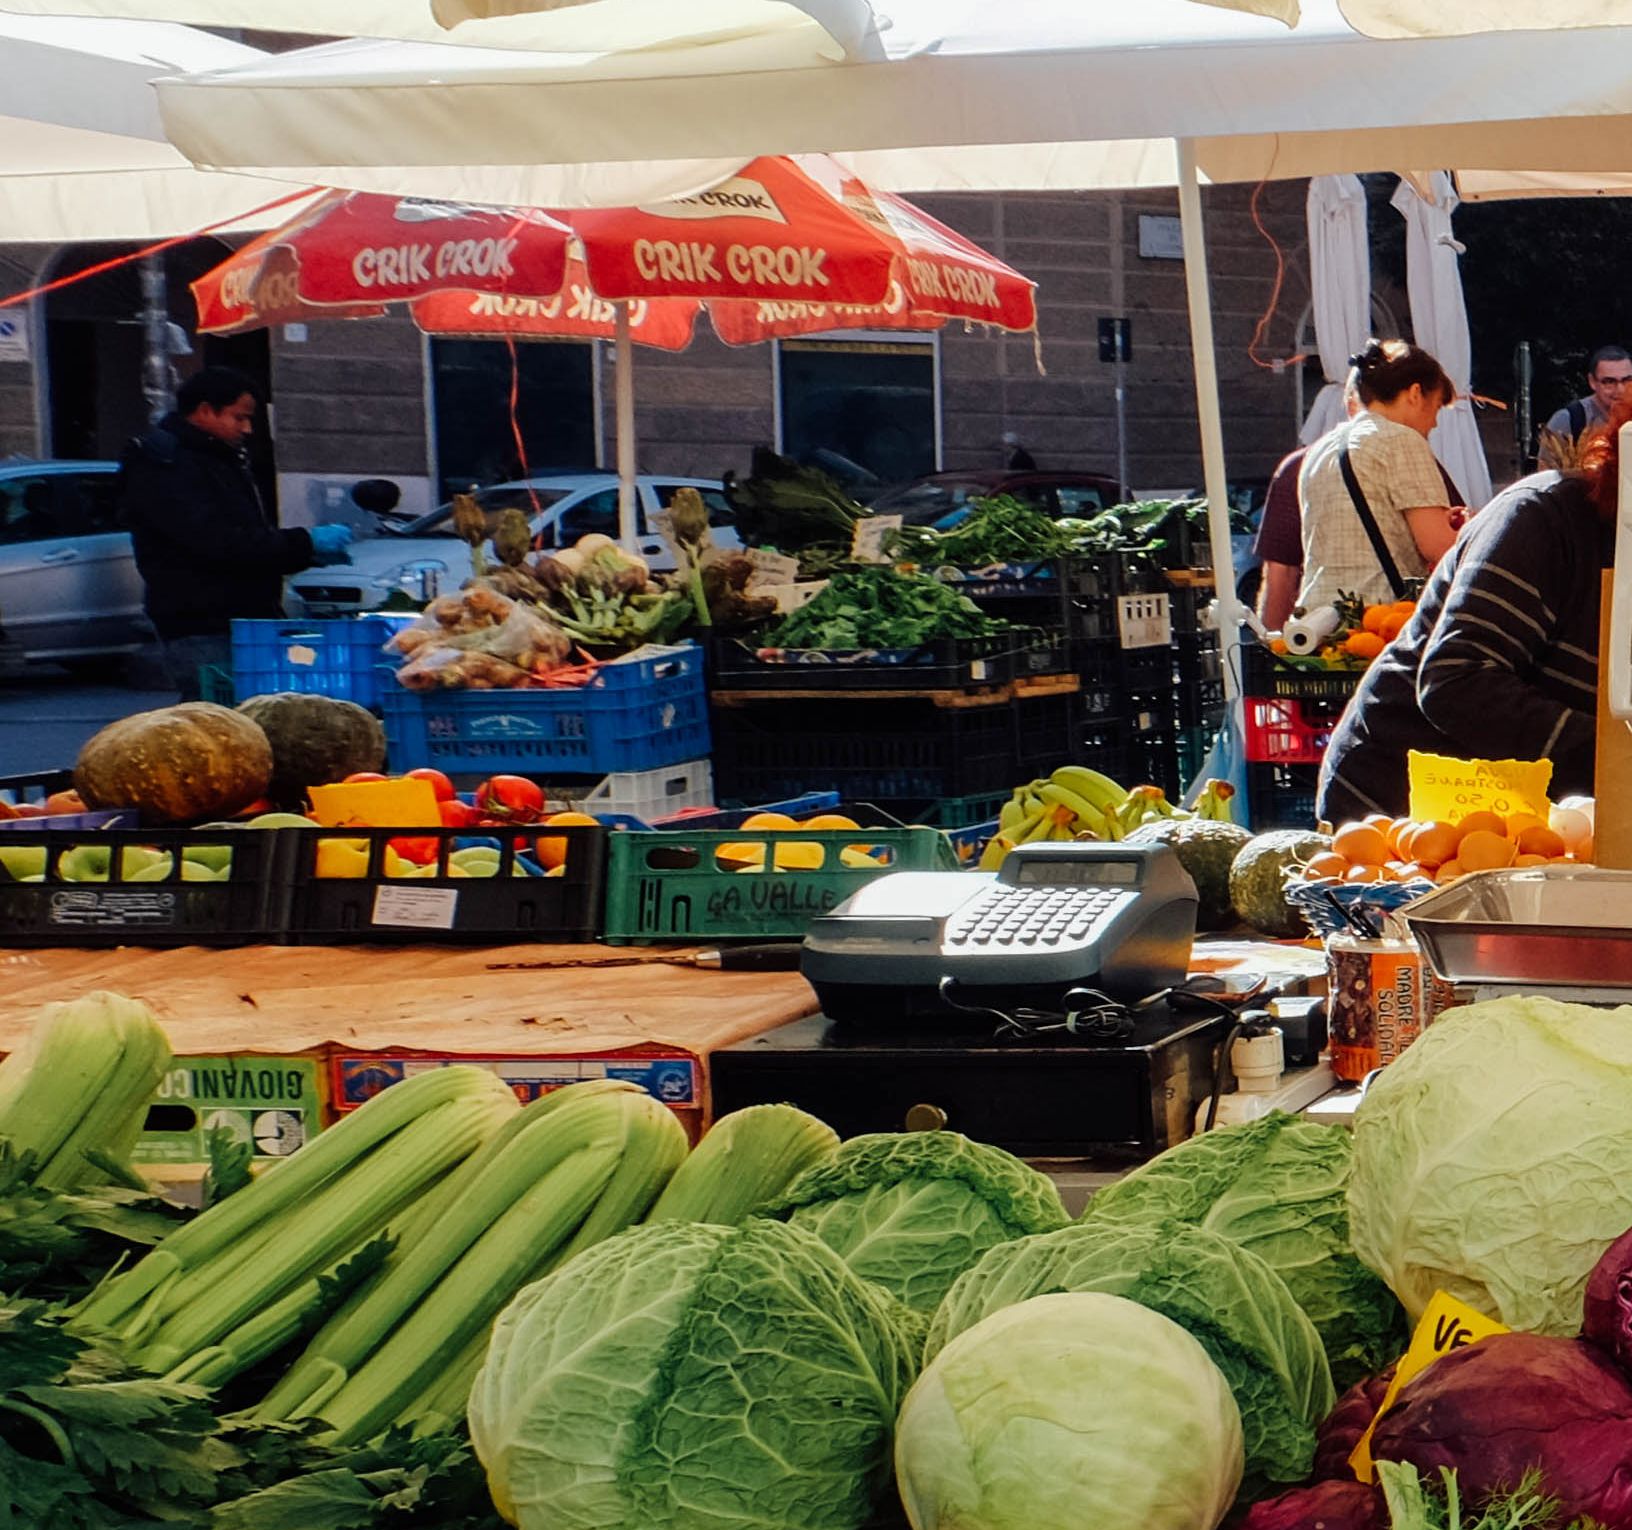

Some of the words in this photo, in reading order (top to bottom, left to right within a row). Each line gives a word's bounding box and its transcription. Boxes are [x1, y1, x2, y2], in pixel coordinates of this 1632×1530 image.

[699, 191, 772, 211] CROK
[353, 243, 433, 289] CRIK
[435, 237, 519, 278] CROK
[633, 237, 721, 284] CRIK
[726, 243, 830, 288] CROK
[906, 257, 947, 299] CRIK
[946, 266, 1000, 308] CROK
[1396, 967, 1414, 1027] MADRE
